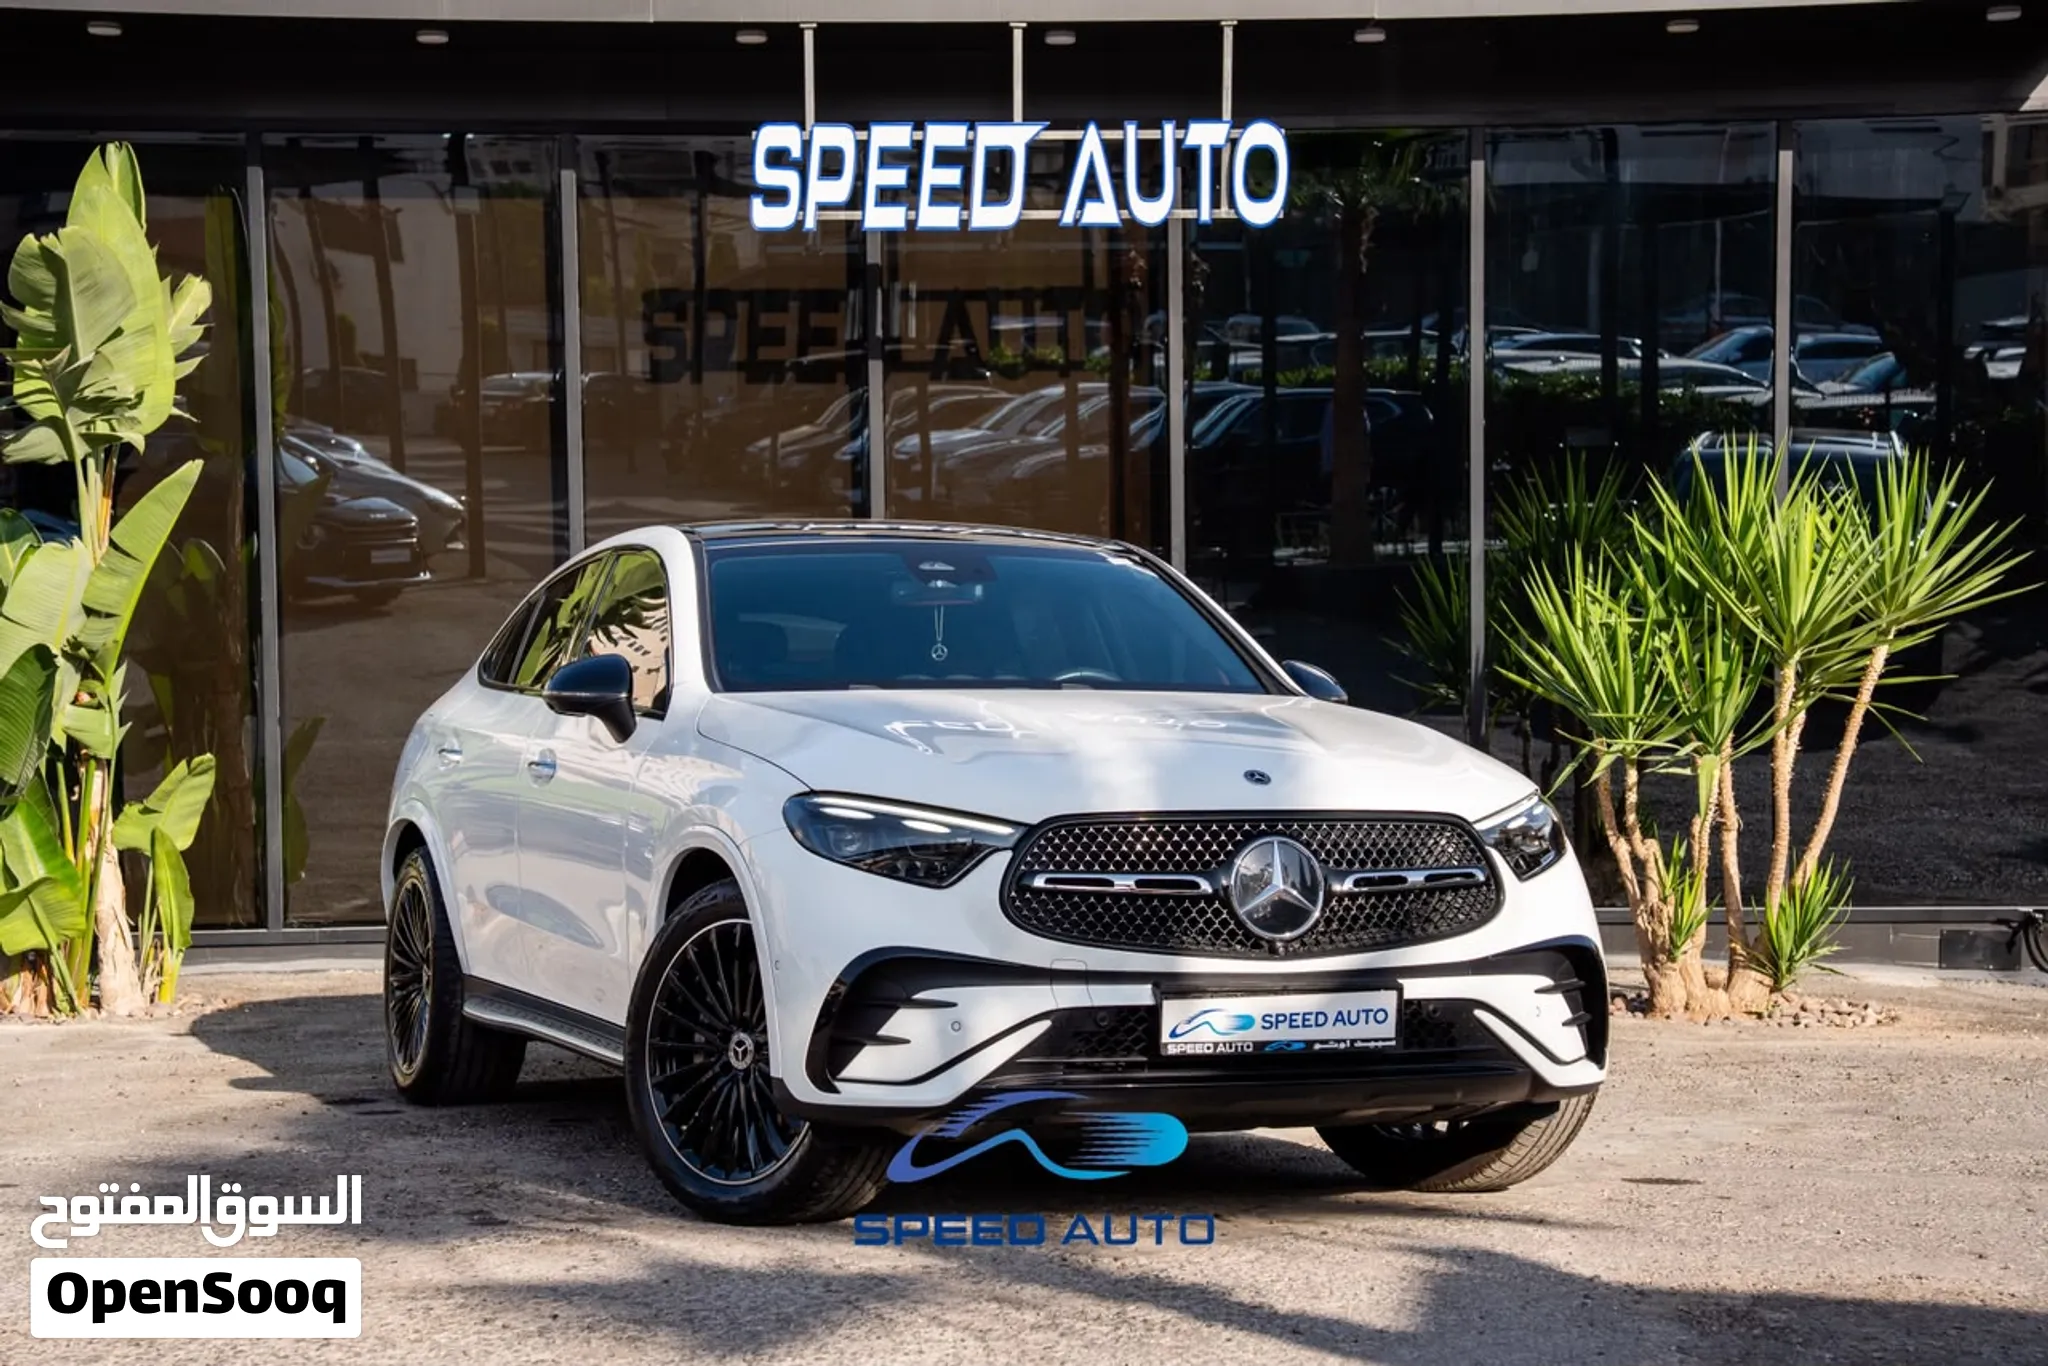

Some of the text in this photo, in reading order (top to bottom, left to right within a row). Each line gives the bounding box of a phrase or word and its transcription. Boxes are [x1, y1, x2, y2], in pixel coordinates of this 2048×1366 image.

[750, 120, 1289, 231] SPEED AUTO
[1261, 1008, 1389, 1030] SPEED AUTO
[1167, 1041, 1254, 1055] SPEED AUTO
